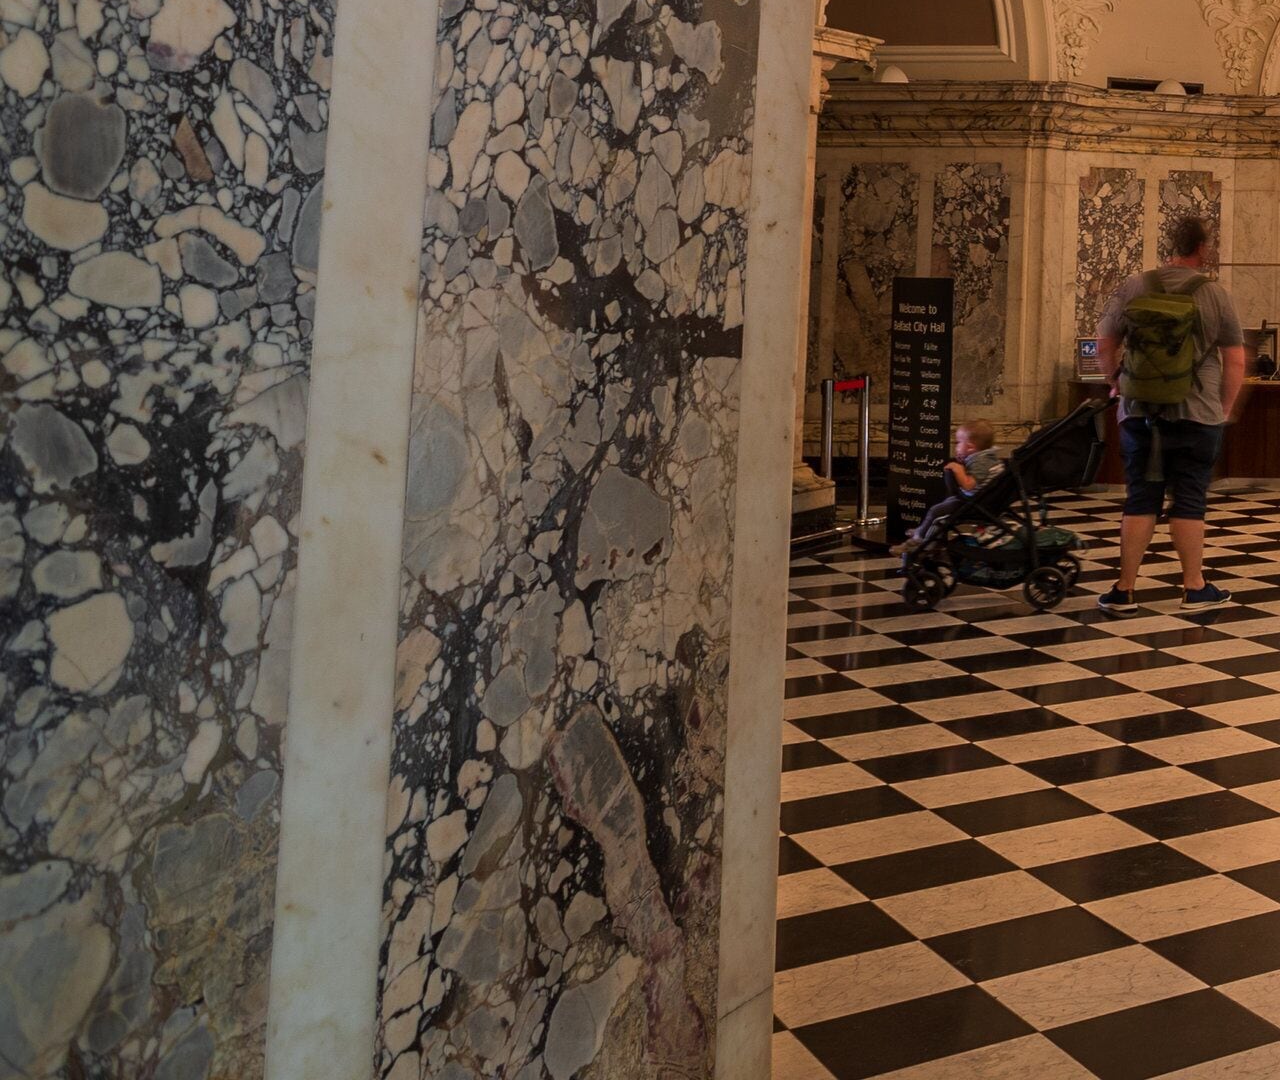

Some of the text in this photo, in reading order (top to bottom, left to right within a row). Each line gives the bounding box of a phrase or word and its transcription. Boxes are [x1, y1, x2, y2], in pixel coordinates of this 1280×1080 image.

[899, 303, 938, 315] Welcome to
[893, 320, 945, 334] Belfast City Hall
